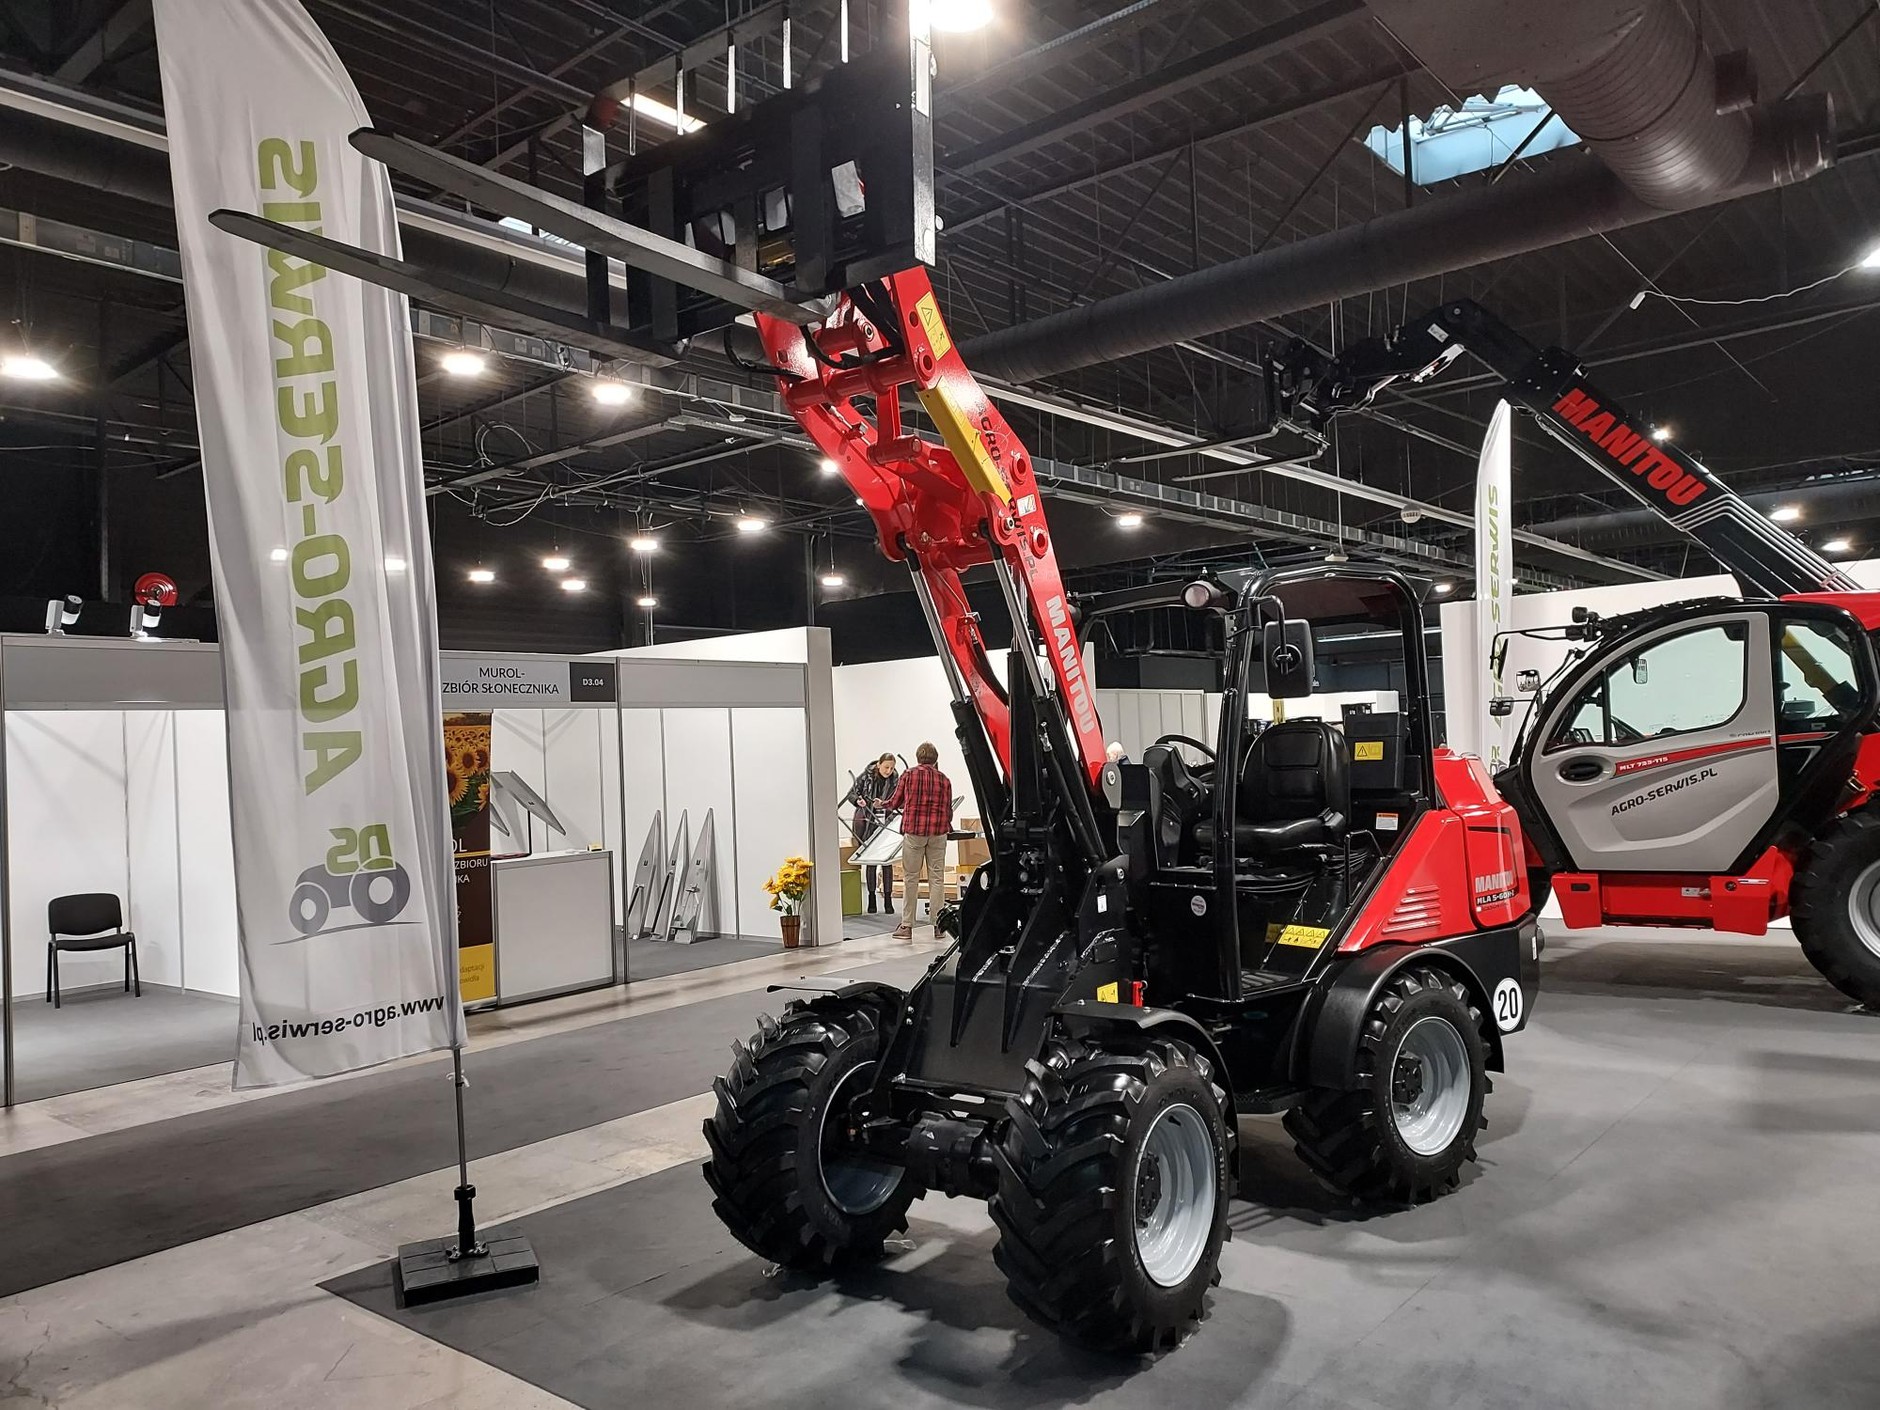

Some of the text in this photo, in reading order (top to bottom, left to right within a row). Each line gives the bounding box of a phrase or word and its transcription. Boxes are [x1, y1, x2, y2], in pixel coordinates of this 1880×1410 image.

[1552, 387, 1708, 506] MANITOU
[479, 667, 526, 679] MUROL-
[1046, 594, 1096, 735] MANITOU
[442, 679, 560, 695] ZBIÓR SŁONECZNIKA
[582, 678, 605, 687] D3.04
[1611, 768, 1718, 816] AGRO-SERWIS.PL
[1498, 987, 1519, 1021] 20
